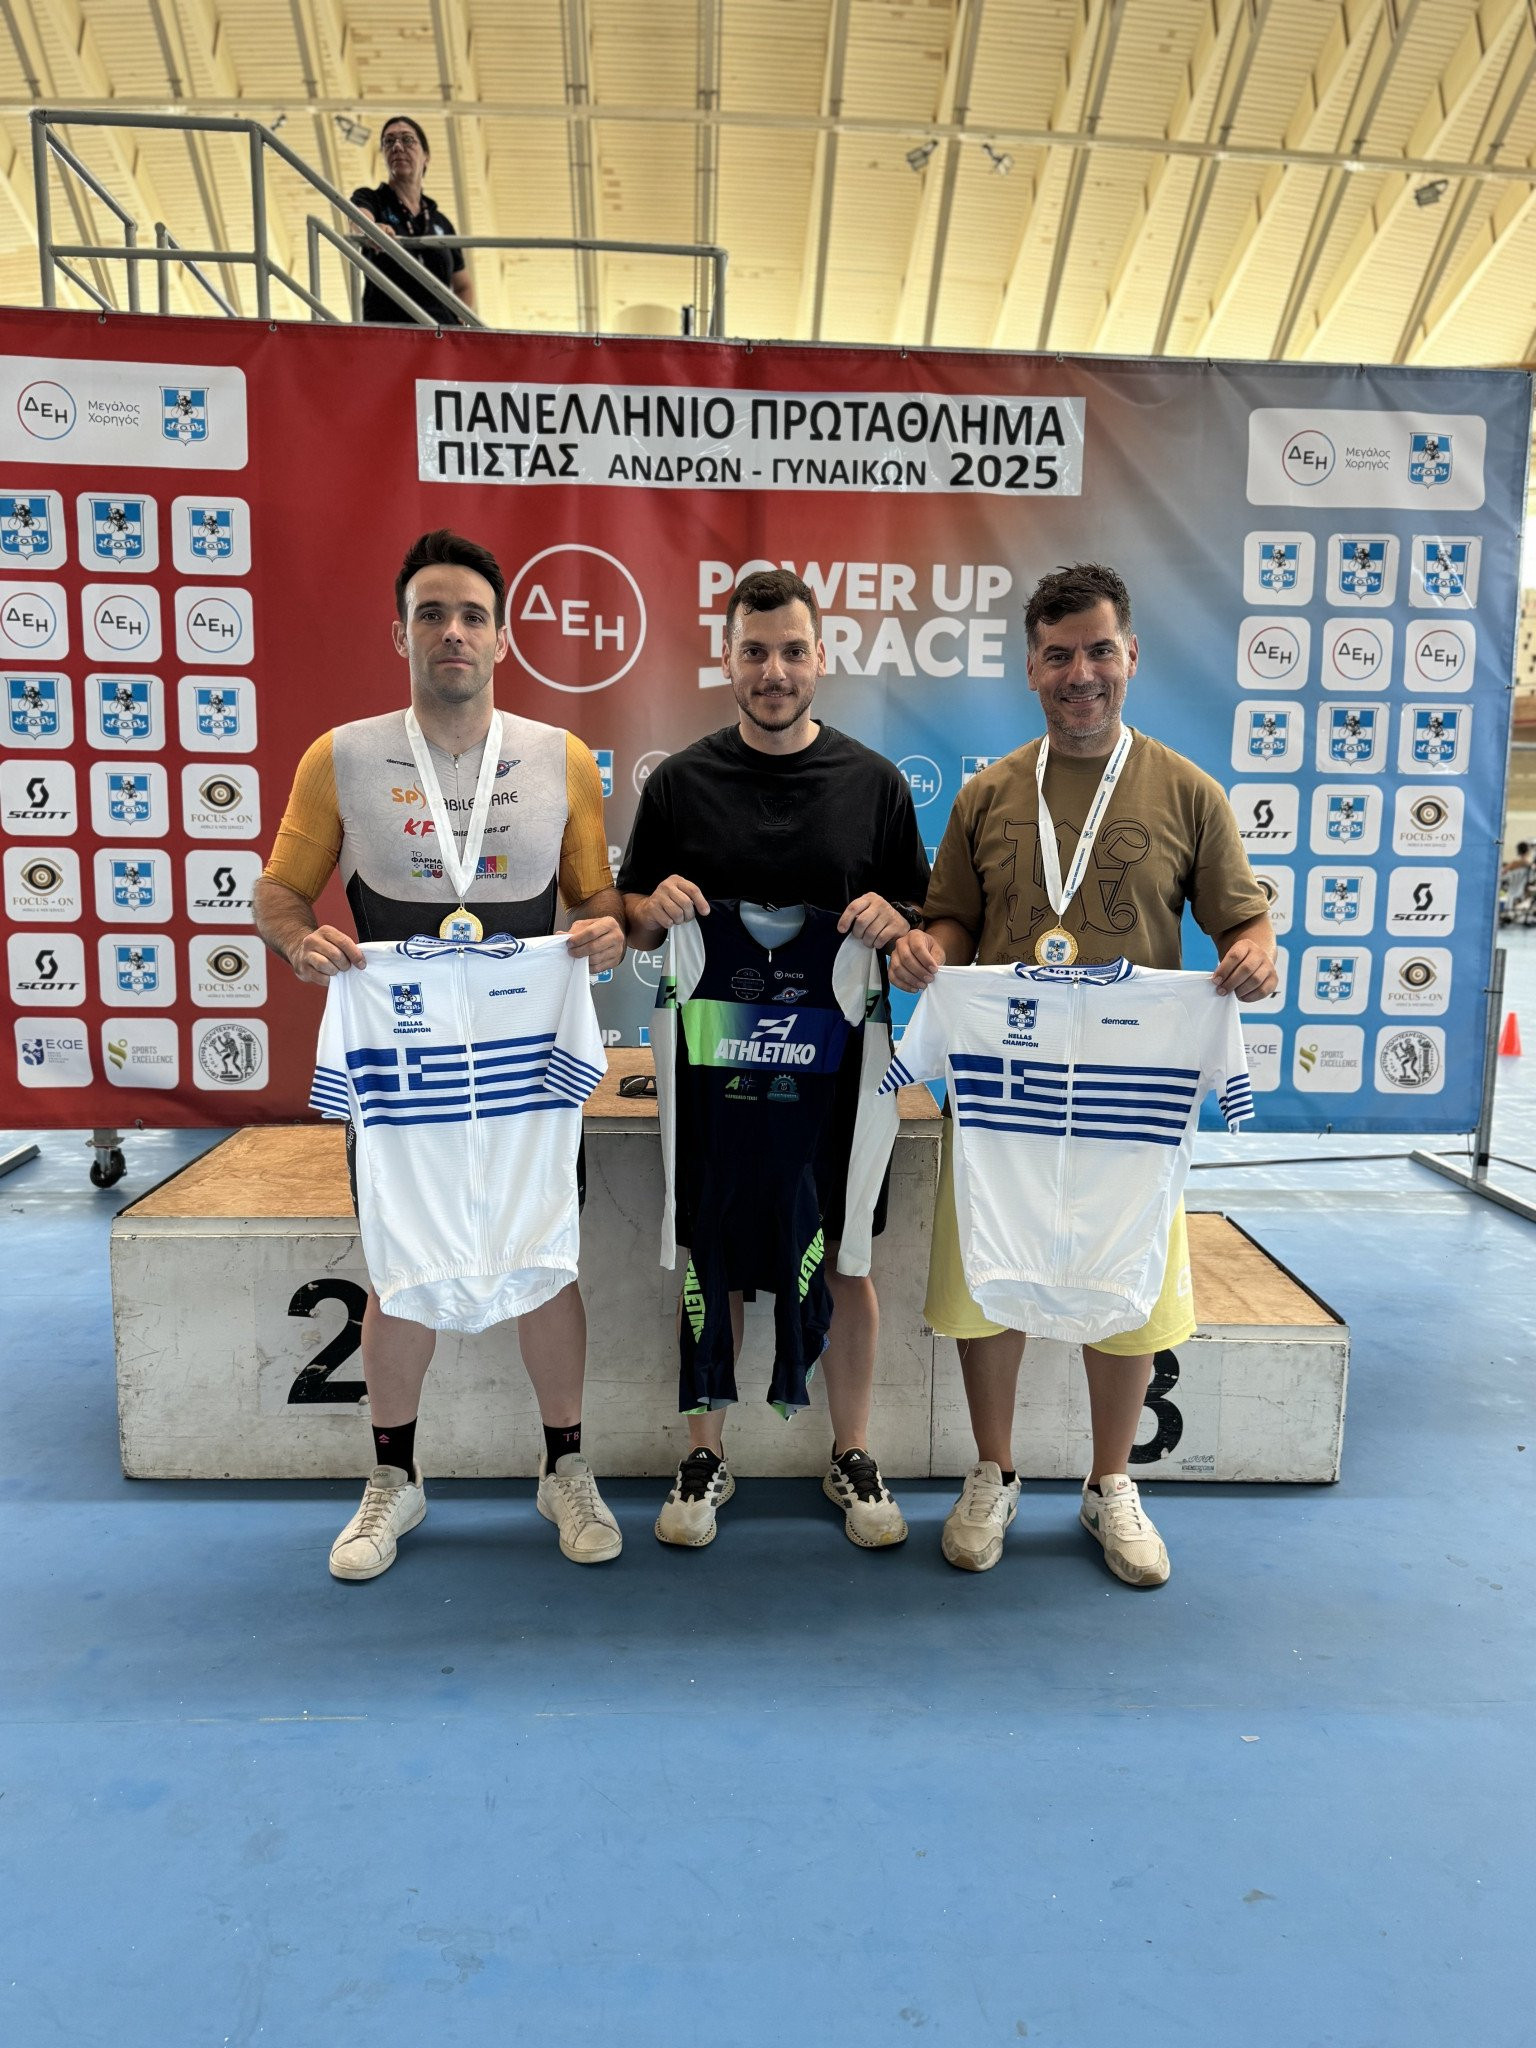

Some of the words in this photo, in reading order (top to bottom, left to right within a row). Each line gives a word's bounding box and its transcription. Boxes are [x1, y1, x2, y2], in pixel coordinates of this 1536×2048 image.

[24, 396, 68, 424] ΔΕΗ
[88, 400, 140, 415] Μεγάλος
[434, 389, 735, 440] ΠΑΝΕΛΛΗΝΙΟ
[751, 398, 1065, 446] ΠΡΩΤΑΘΛΗΜΑ
[88, 413, 139, 426] Χορηγός
[438, 441, 579, 478] ΠΙΣΤΑΣ
[608, 454, 741, 483] ΑΝΔΡΩΝ
[773, 458, 926, 486] ΓΥΝΑΙΚΩΝ
[949, 452, 1058, 489] 2025
[1288, 446, 1327, 470] ΔΕΗ
[1345, 459, 1389, 470] Χορηγός
[1346, 448, 1391, 460] Μεγάλος
[932, 564, 1012, 612] UP
[7, 608, 48, 633] ΔΕΗ
[101, 611, 142, 635] ΔΕΗ
[192, 613, 234, 638] ΔΕΗ
[520, 583, 625, 652] ΔΕΗ
[822, 616, 1007, 678] RACE
[1254, 641, 1291, 664] ΔΕΗ
[1338, 643, 1375, 665] ΔΕΗ
[1420, 644, 1457, 667] ΔΕΗ
[489, 791, 519, 807] ARE
[7, 811, 71, 820] SCOTT
[1392, 913, 1450, 922] SCOTT
[638, 951, 663, 968] ΔΕ
[16, 982, 79, 991] SCOTT
[131, 1046, 158, 1054] SPORTS
[713, 1038, 816, 1066] ATHLETIKO
[1002, 1039, 1039, 1048] CHAMPION
[131, 1055, 174, 1064] EXCELLENCE
[287, 1278, 369, 1404] 2
